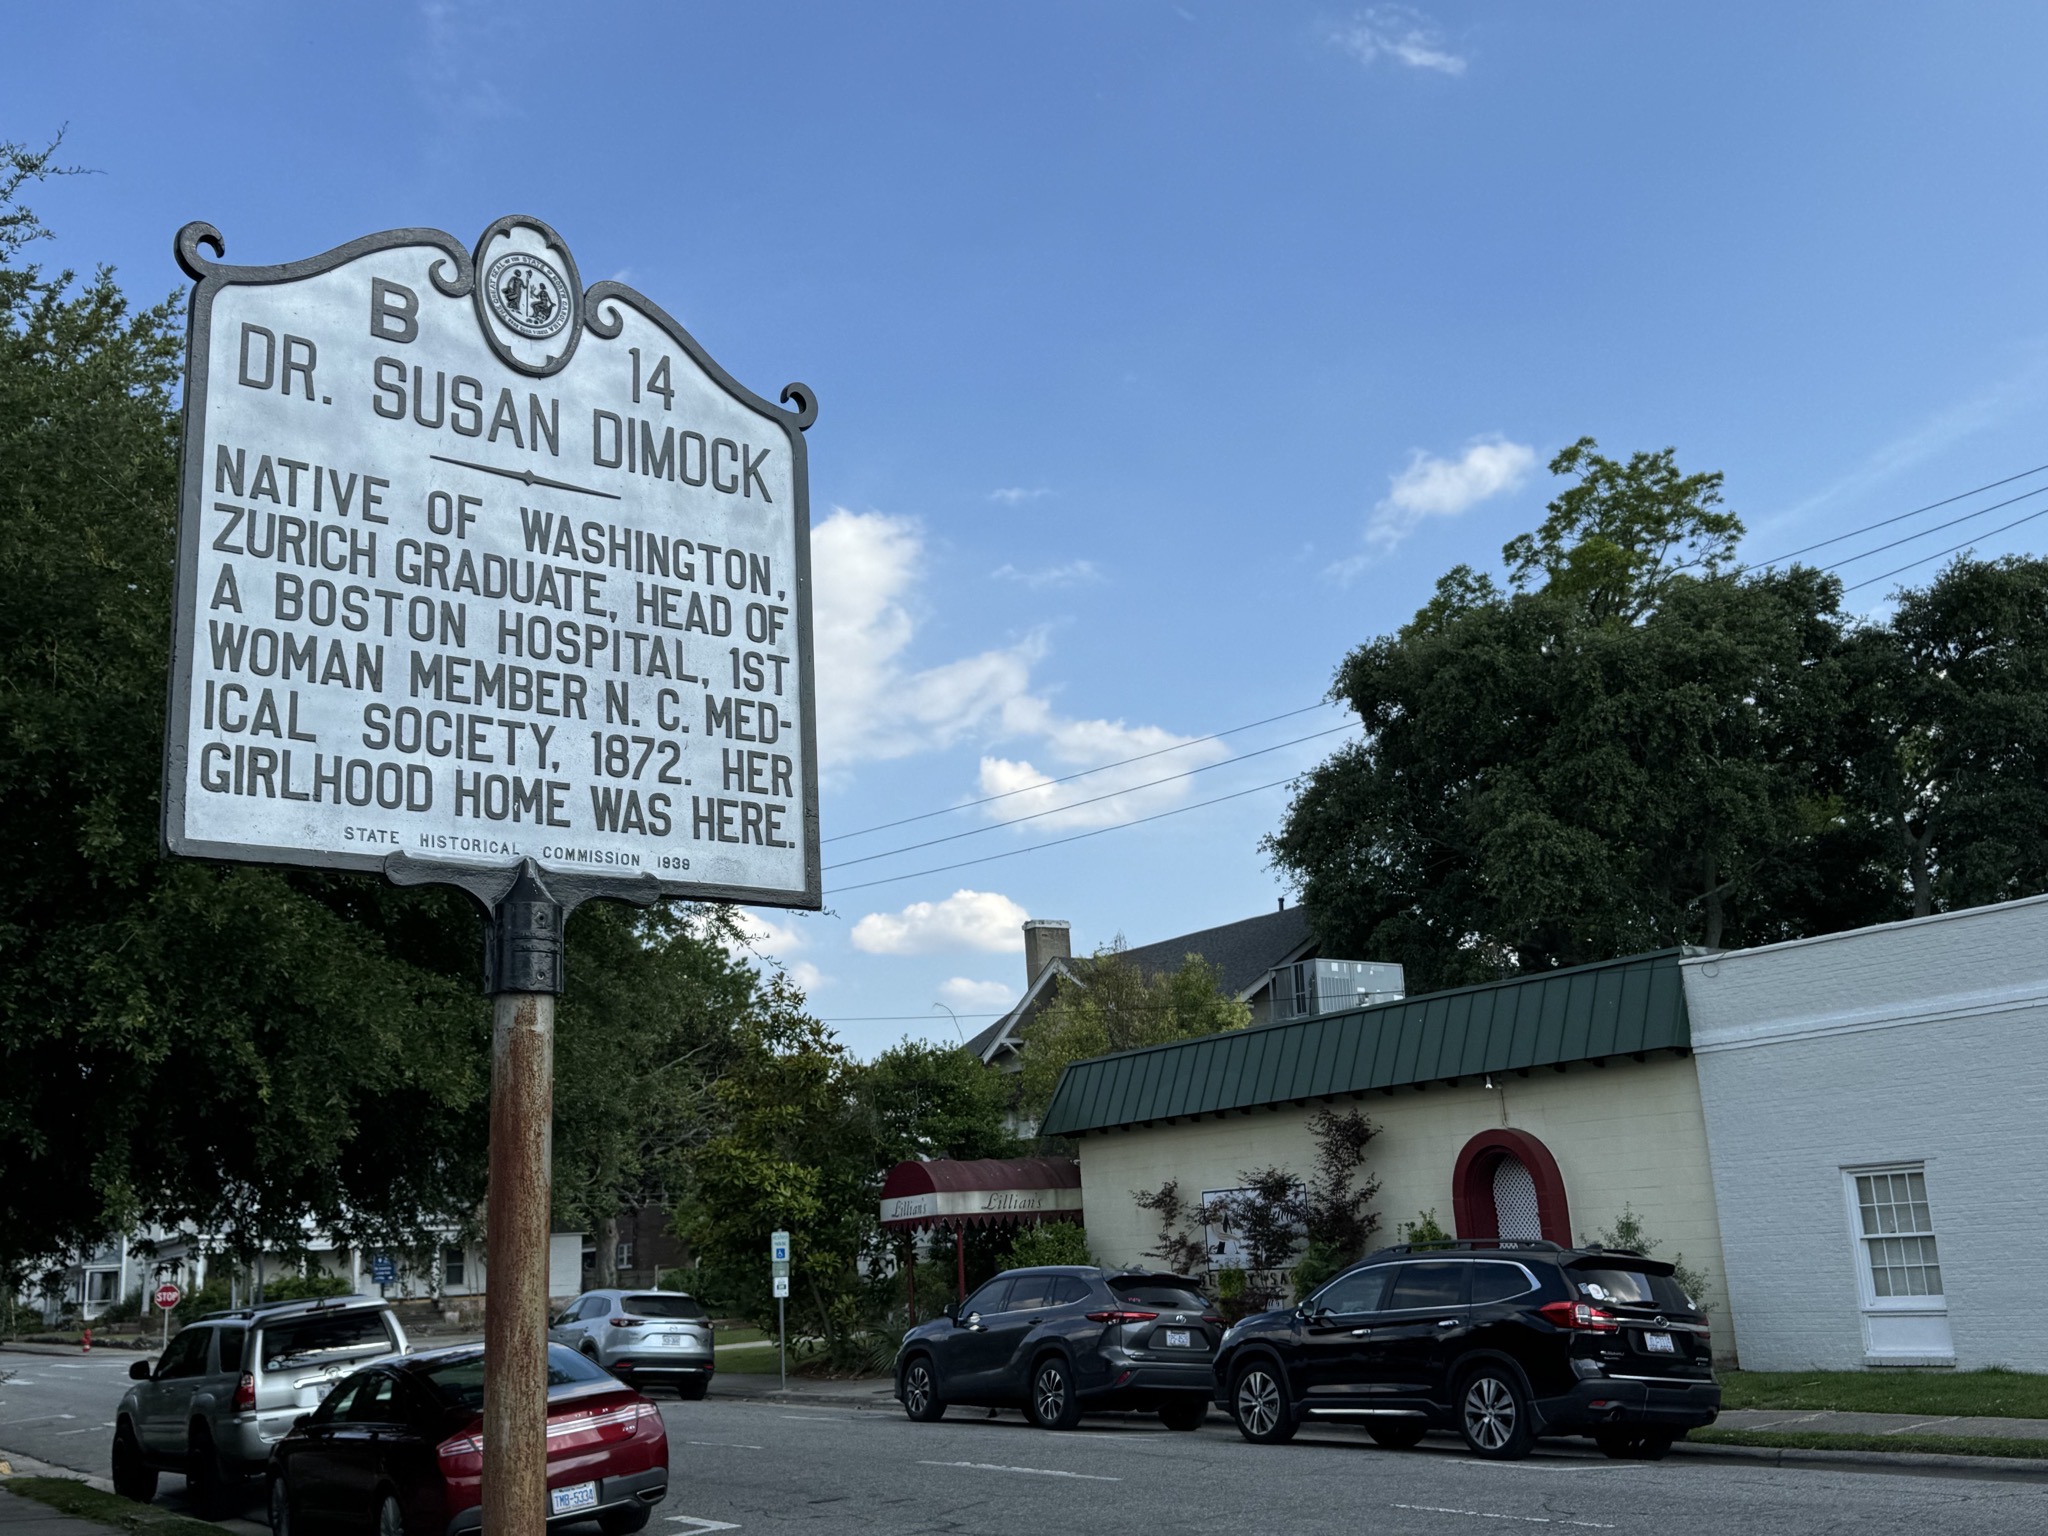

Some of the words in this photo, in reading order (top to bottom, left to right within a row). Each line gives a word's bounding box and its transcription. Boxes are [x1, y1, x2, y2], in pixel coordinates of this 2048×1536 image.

[491, 261, 506, 278] SEAL
[522, 257, 546, 271] STATE
[552, 275, 567, 299] NORTH
[370, 277, 418, 344] B
[548, 300, 568, 332] CAROLINA
[629, 348, 674, 411] 14
[239, 323, 331, 405] DR.
[373, 357, 559, 457] SUSAN
[594, 409, 772, 503] DIMOCK
[215, 445, 389, 525] NATIVE
[428, 491, 482, 539] OF
[520, 507, 785, 601] WASHINGTON,
[213, 503, 376, 578] ZURICH
[396, 539, 617, 623] GRADUATE,
[637, 581, 731, 637] HEAD
[746, 603, 788, 645] OF
[210, 563, 242, 613] A
[275, 572, 465, 648] BOSTON
[498, 610, 709, 689] HOSPITAL,
[729, 648, 789, 696] 1ST
[209, 620, 383, 693] WOMAN
[410, 651, 587, 720] MEMBER
[606, 680, 640, 727] N.
[657, 688, 689, 733] C.
[706, 694, 791, 744] MED-
[204, 680, 316, 743] ICAL
[363, 703, 559, 773] SOCIETY,
[591, 731, 691, 786] 1872.
[722, 748, 793, 798] HER
[201, 743, 432, 812] GIRLHOOD
[455, 770, 571, 828] HOME
[590, 786, 671, 837] WAS
[692, 796, 795, 849] HERE.
[344, 826, 399, 845] STATE
[420, 833, 520, 855] HISTORICAL
[543, 846, 640, 866] COMMISSION
[657, 856, 690, 870] 1939
[891, 1197, 927, 1217] Lillian's
[980, 1192, 1042, 1210] Lillian's
[156, 1291, 178, 1302] STOP
